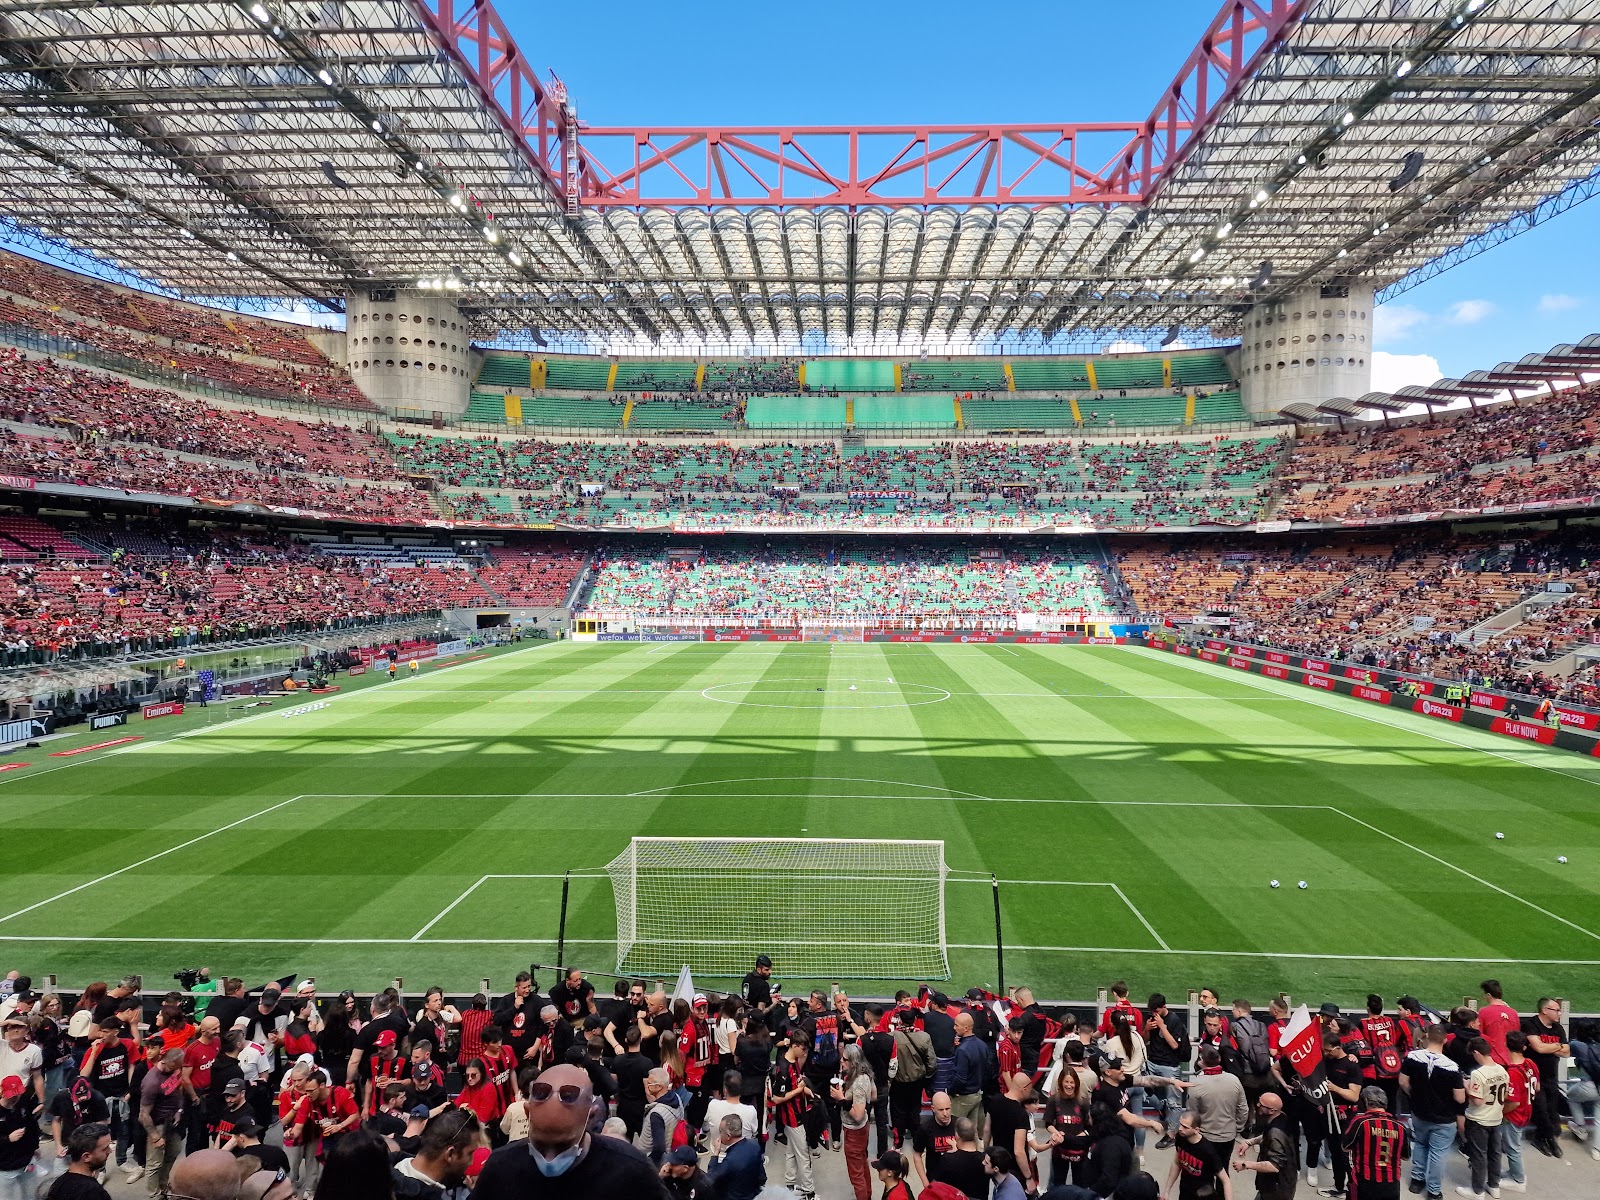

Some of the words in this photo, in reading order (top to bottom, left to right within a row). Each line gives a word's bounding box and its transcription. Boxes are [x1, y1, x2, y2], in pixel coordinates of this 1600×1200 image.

[1206, 604, 1238, 612] ARCORE
[1479, 695, 1492, 706] NOW!
[146, 705, 172, 718] Emirates
[1430, 704, 1442, 716] FIFA
[94, 715, 115, 729] PUMA
[1506, 722, 1520, 735] PLAY
[1520, 726, 1538, 740] NOW!
[697, 1036, 709, 1060] 11
[1485, 1083, 1506, 1105] 30
[1372, 1126, 1399, 1140] MALDINI
